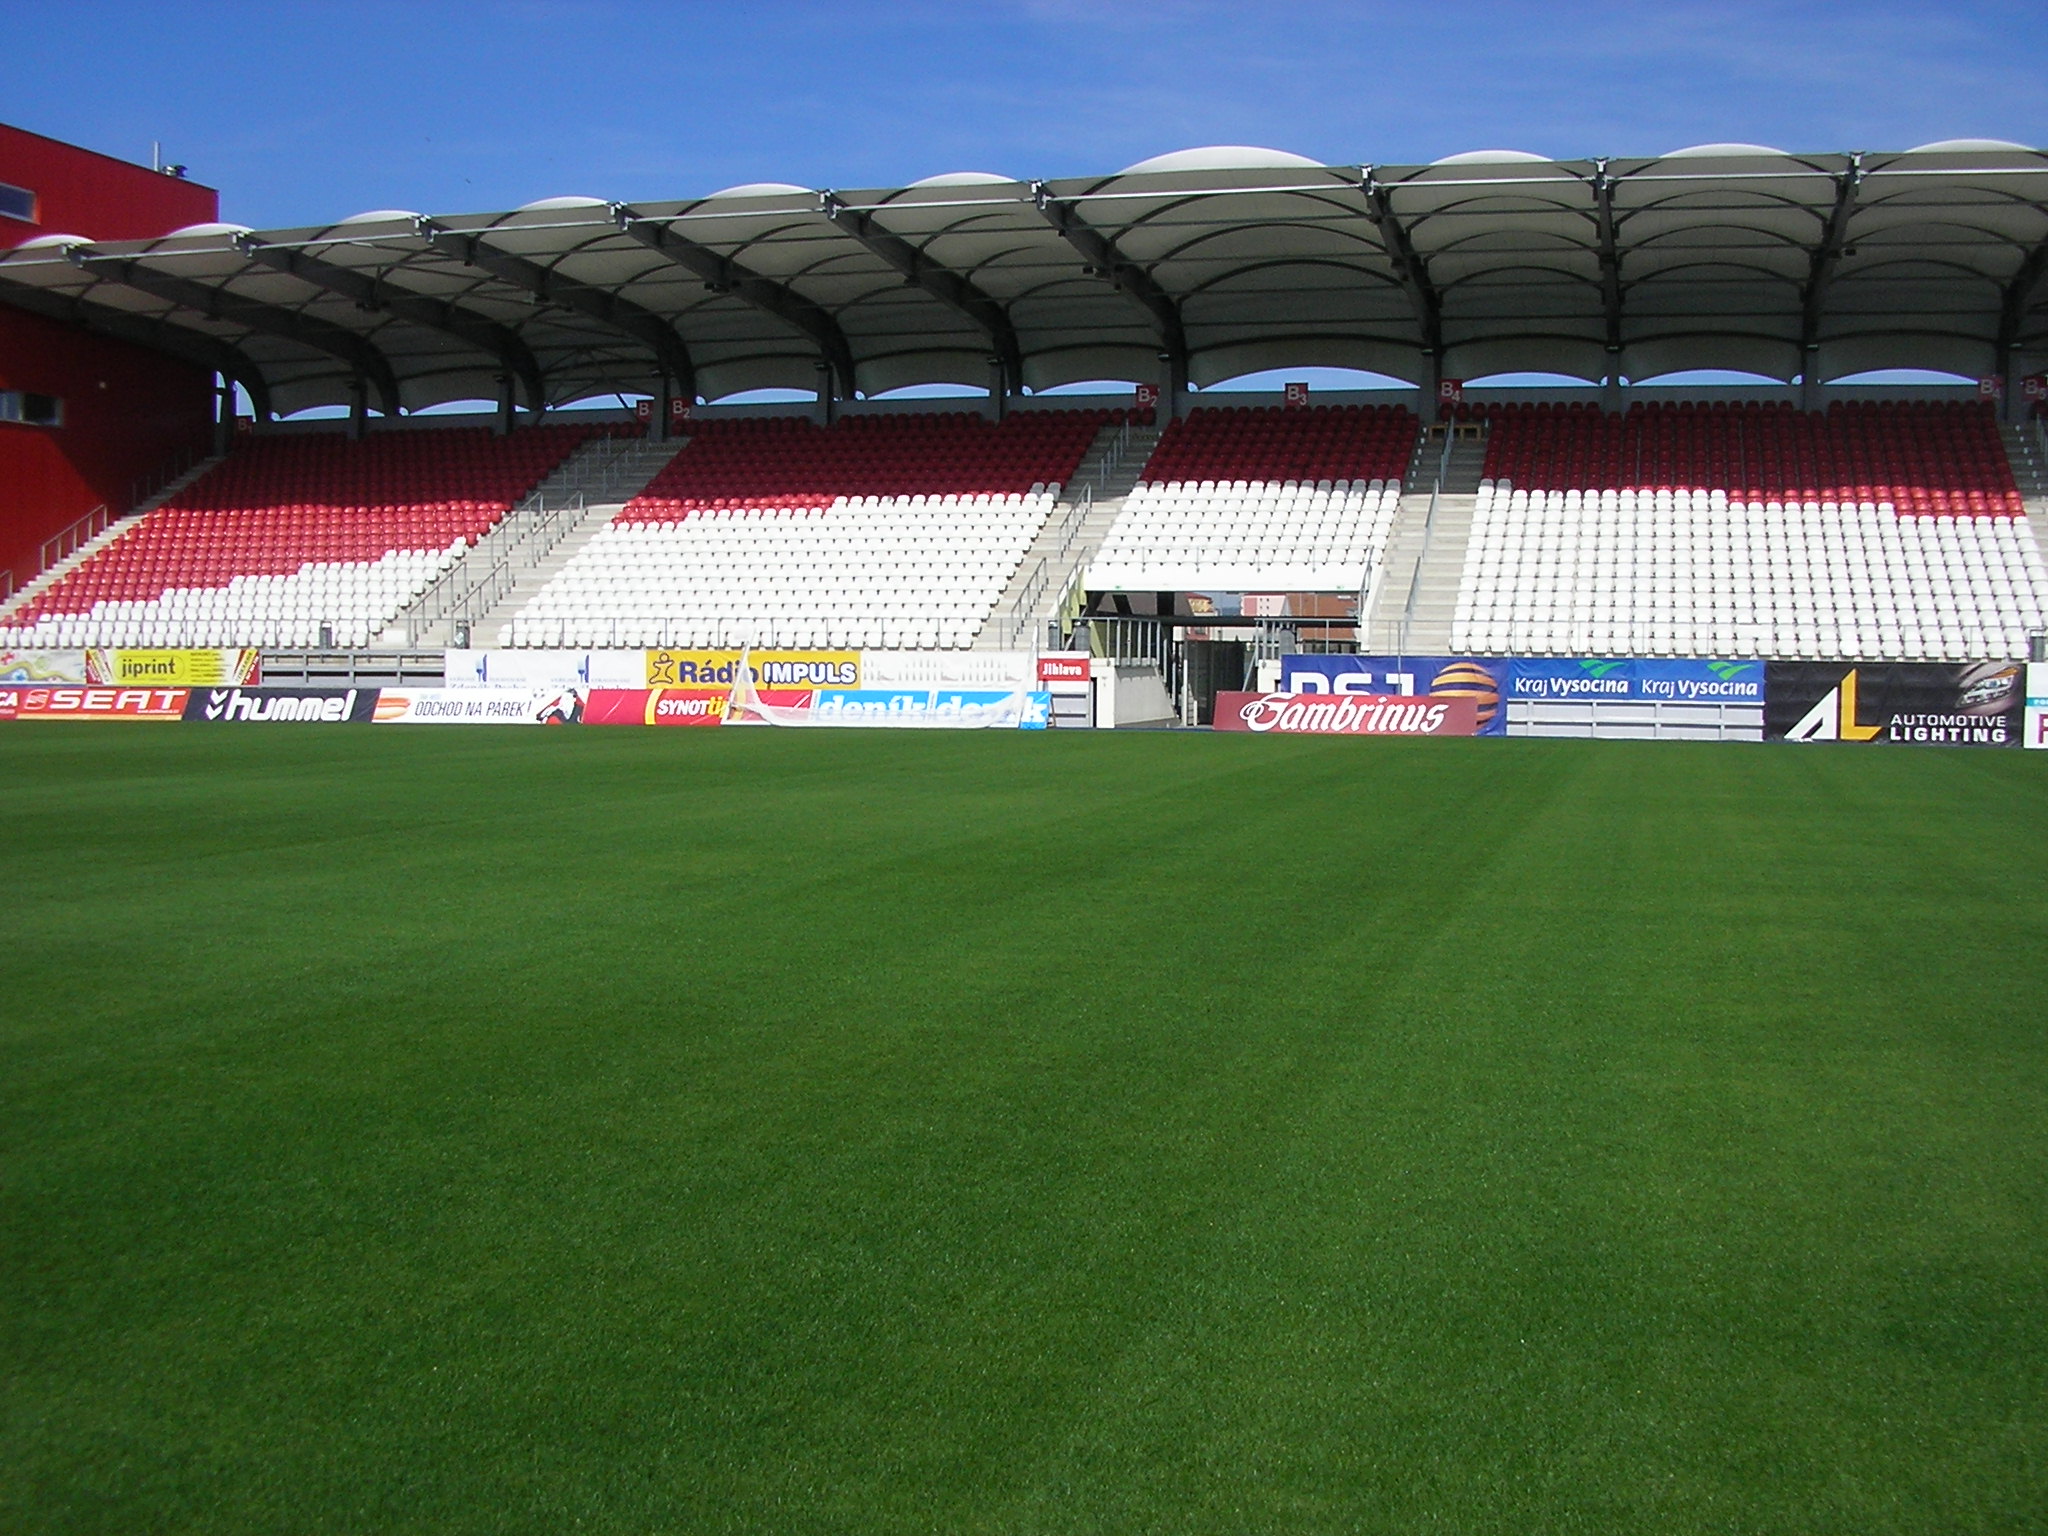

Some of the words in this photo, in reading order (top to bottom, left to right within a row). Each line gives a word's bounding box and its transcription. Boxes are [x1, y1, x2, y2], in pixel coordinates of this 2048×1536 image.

[1138, 388, 1158, 407] B2
[1288, 386, 1307, 406] B3
[1441, 381, 1461, 401] B4
[673, 400, 690, 418] B2
[122, 658, 176, 677] jiprint
[763, 661, 857, 684] IMPULS
[1043, 662, 1083, 676] Jihlava
[1515, 677, 1548, 697] Kraj
[1642, 679, 1675, 698] Kraj
[49, 690, 187, 710] SEAT
[224, 688, 358, 721] hummel
[415, 701, 463, 717] ODCHOD
[465, 702, 483, 717] NA
[820, 694, 926, 721] deník
[1239, 692, 1449, 732] Gambrinus
[1890, 714, 2007, 727] AUTOMOTIVE
[1890, 727, 2006, 743] LIGHTING
